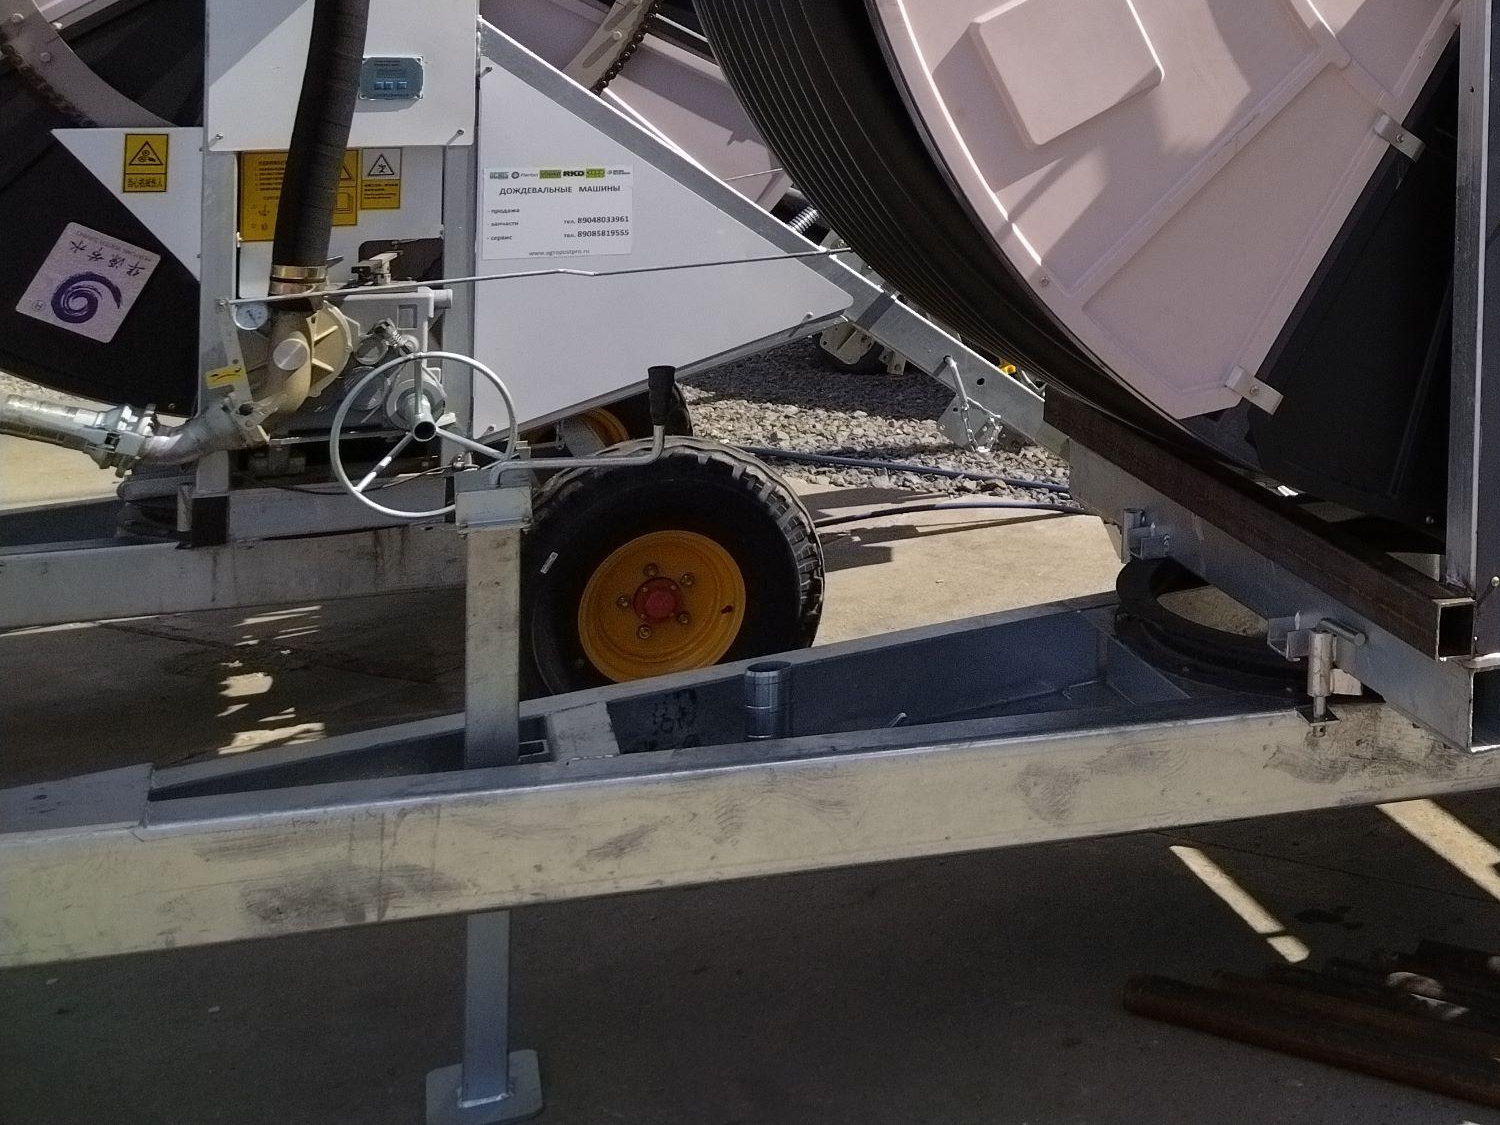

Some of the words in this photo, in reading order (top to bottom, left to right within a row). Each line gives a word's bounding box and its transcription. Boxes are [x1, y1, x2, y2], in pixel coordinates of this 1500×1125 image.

[499, 186, 573, 196] ДОЖДЕВАЛЬНЫЕ
[578, 185, 621, 193] МАШИНЫ
[577, 215, 630, 224] 89048033961
[577, 229, 630, 238] 89085819555
